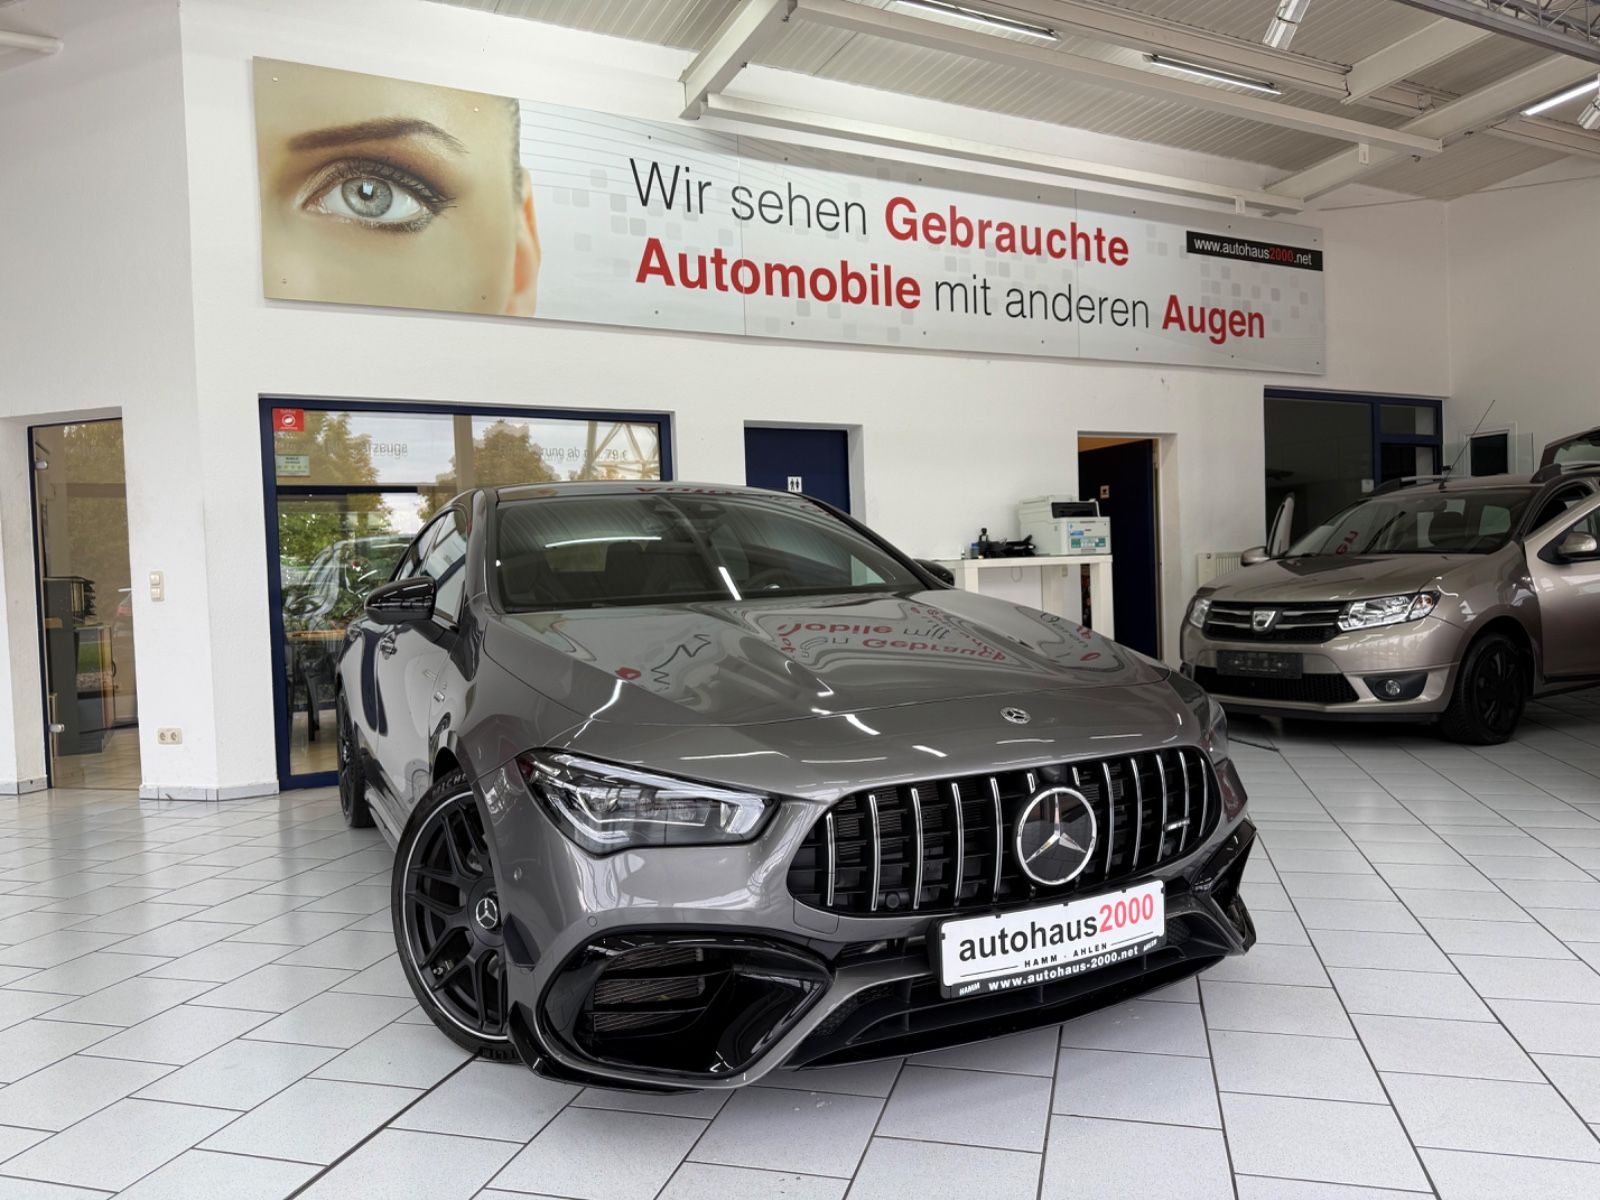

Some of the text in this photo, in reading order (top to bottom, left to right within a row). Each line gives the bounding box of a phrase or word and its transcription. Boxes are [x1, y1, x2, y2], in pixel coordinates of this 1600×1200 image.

[630, 157, 1130, 266] Wir sehen Gebrauchte
[1194, 238, 1313, 266] www.autohaus2000.net
[635, 237, 1265, 345] Automobile mit anderen Augen
[959, 893, 1154, 962] autohaus2000
[1024, 954, 1058, 969] HAMM
[1072, 942, 1108, 958] AHLEN
[988, 945, 1139, 992] www.autohaus-2000.net
